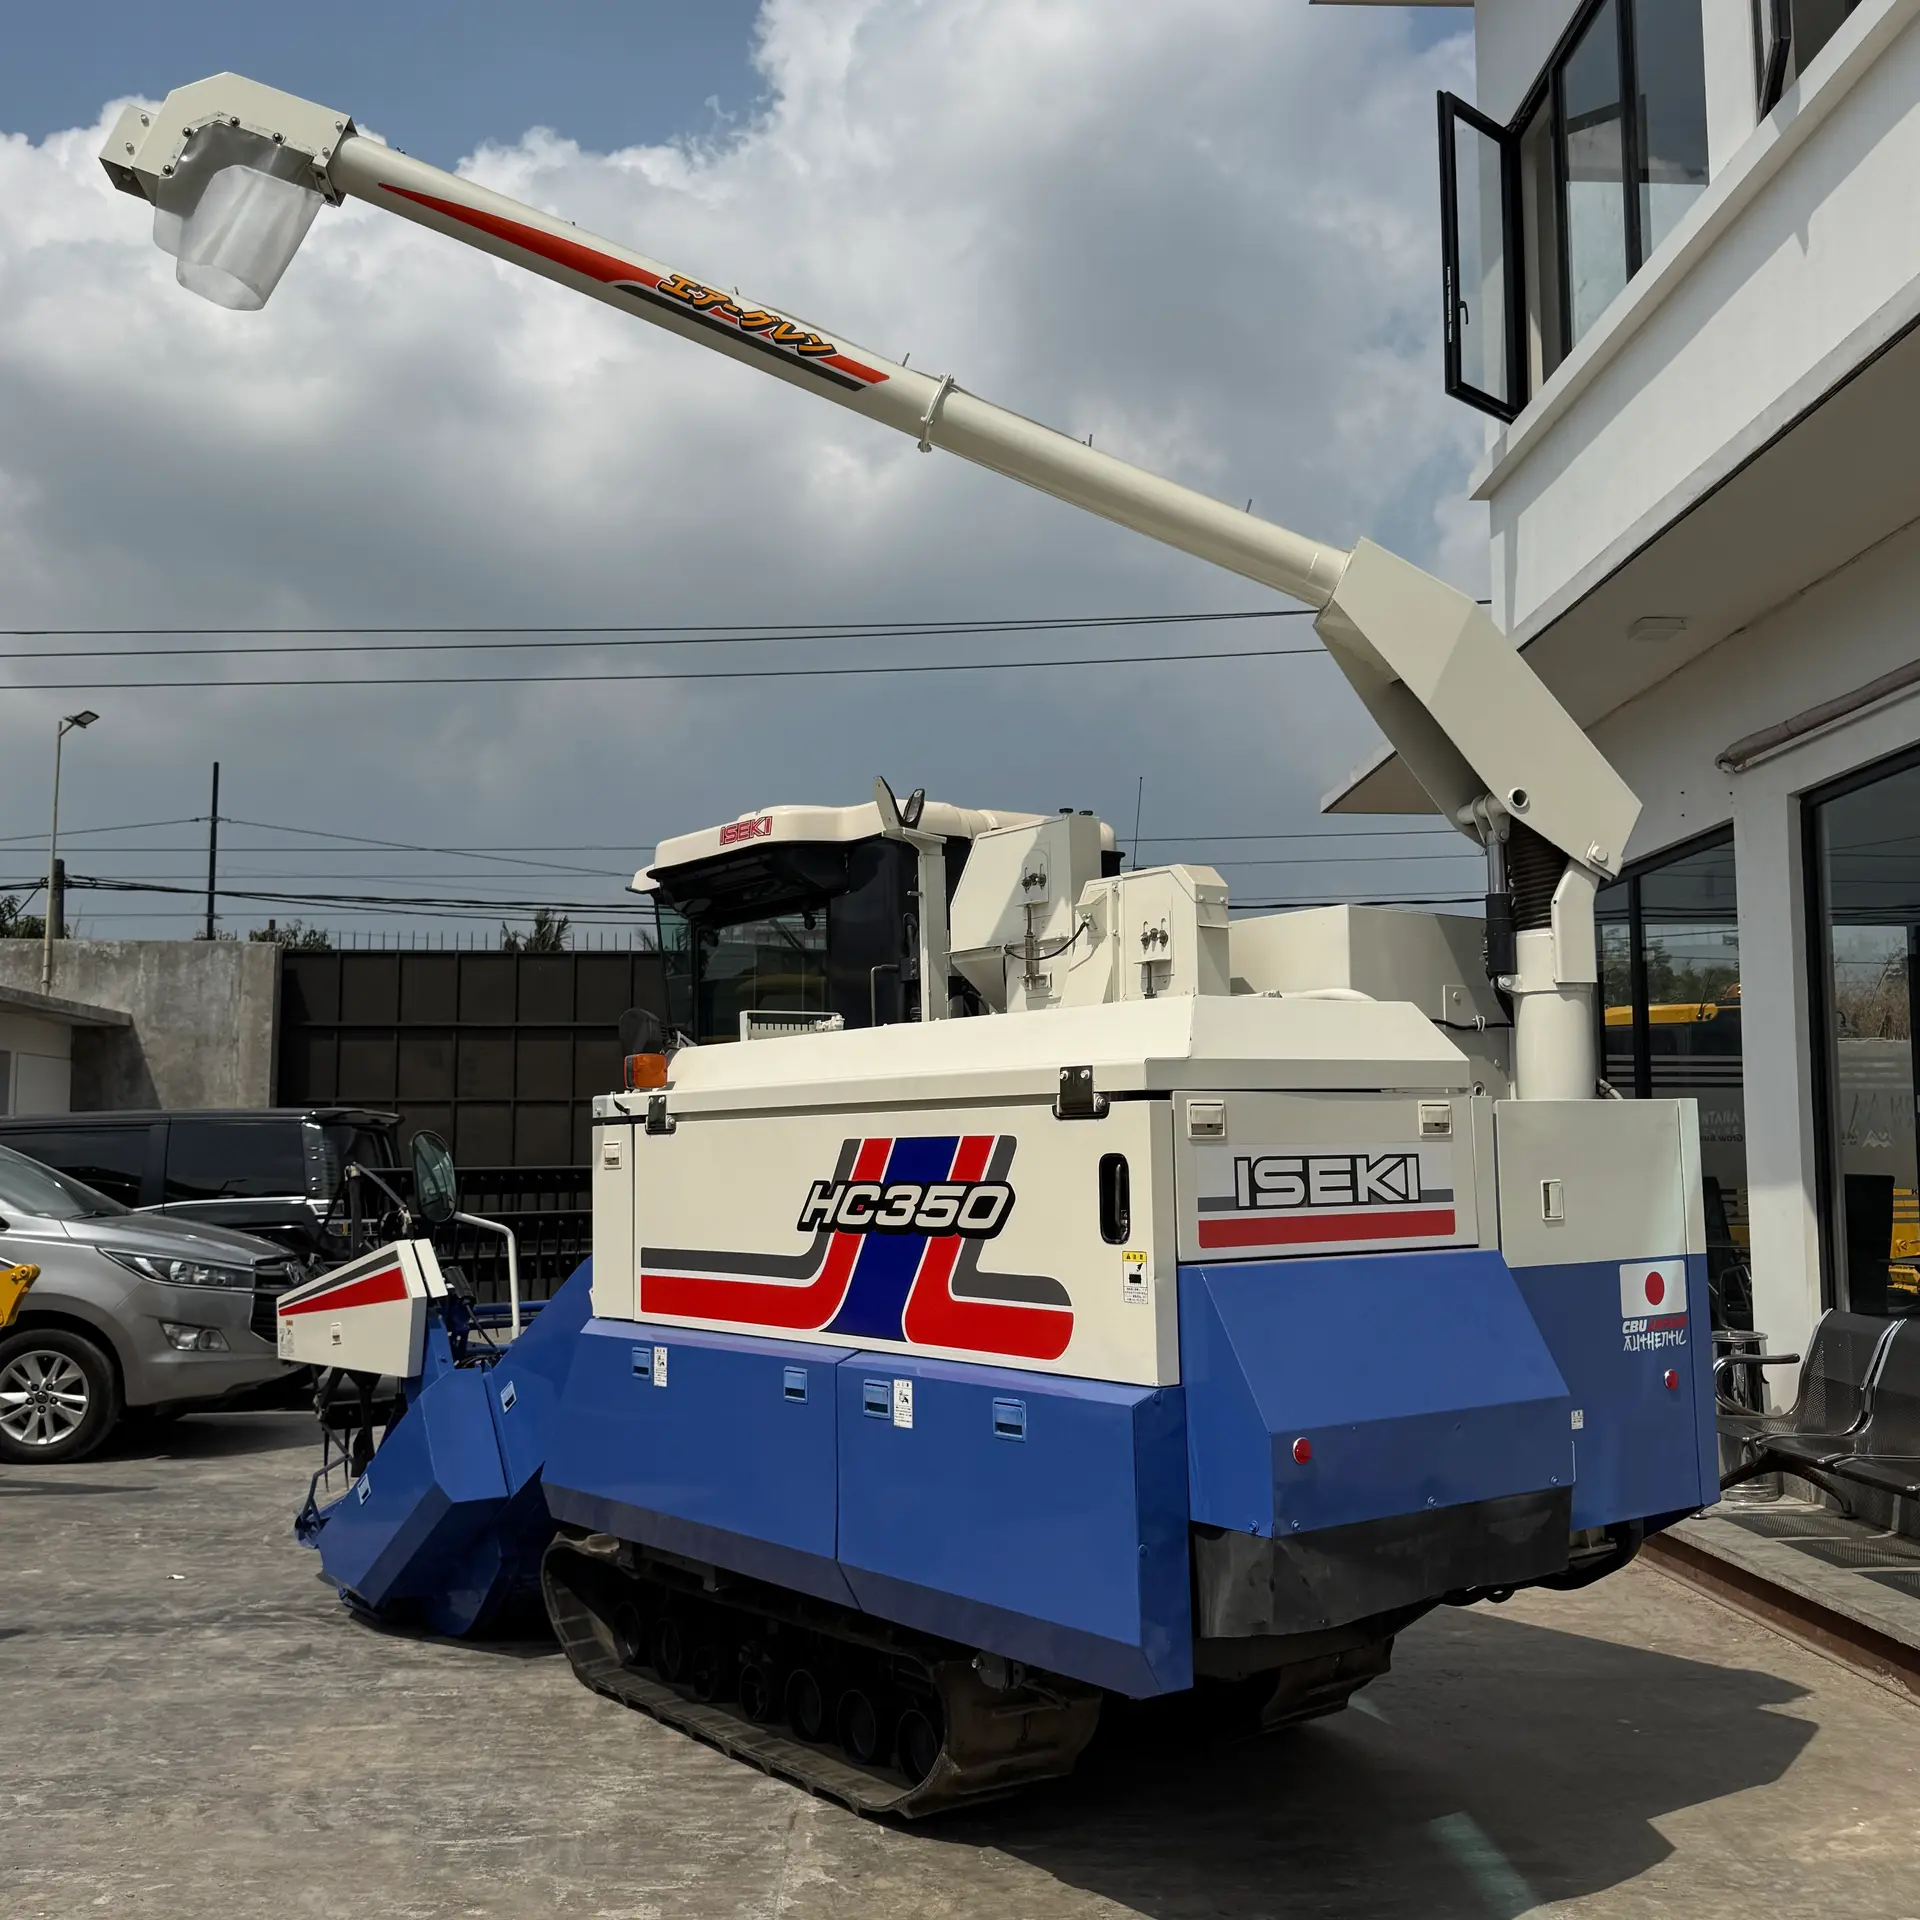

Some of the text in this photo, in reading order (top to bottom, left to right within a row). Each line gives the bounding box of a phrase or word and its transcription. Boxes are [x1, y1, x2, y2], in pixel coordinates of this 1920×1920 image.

[719, 815, 773, 846] ISEKI
[1234, 1153, 1421, 1210] ISEKI
[799, 1182, 1013, 1236] HC350
[1622, 1319, 1647, 1334] CBU
[1623, 1329, 1687, 1352] AUTHENTIC
